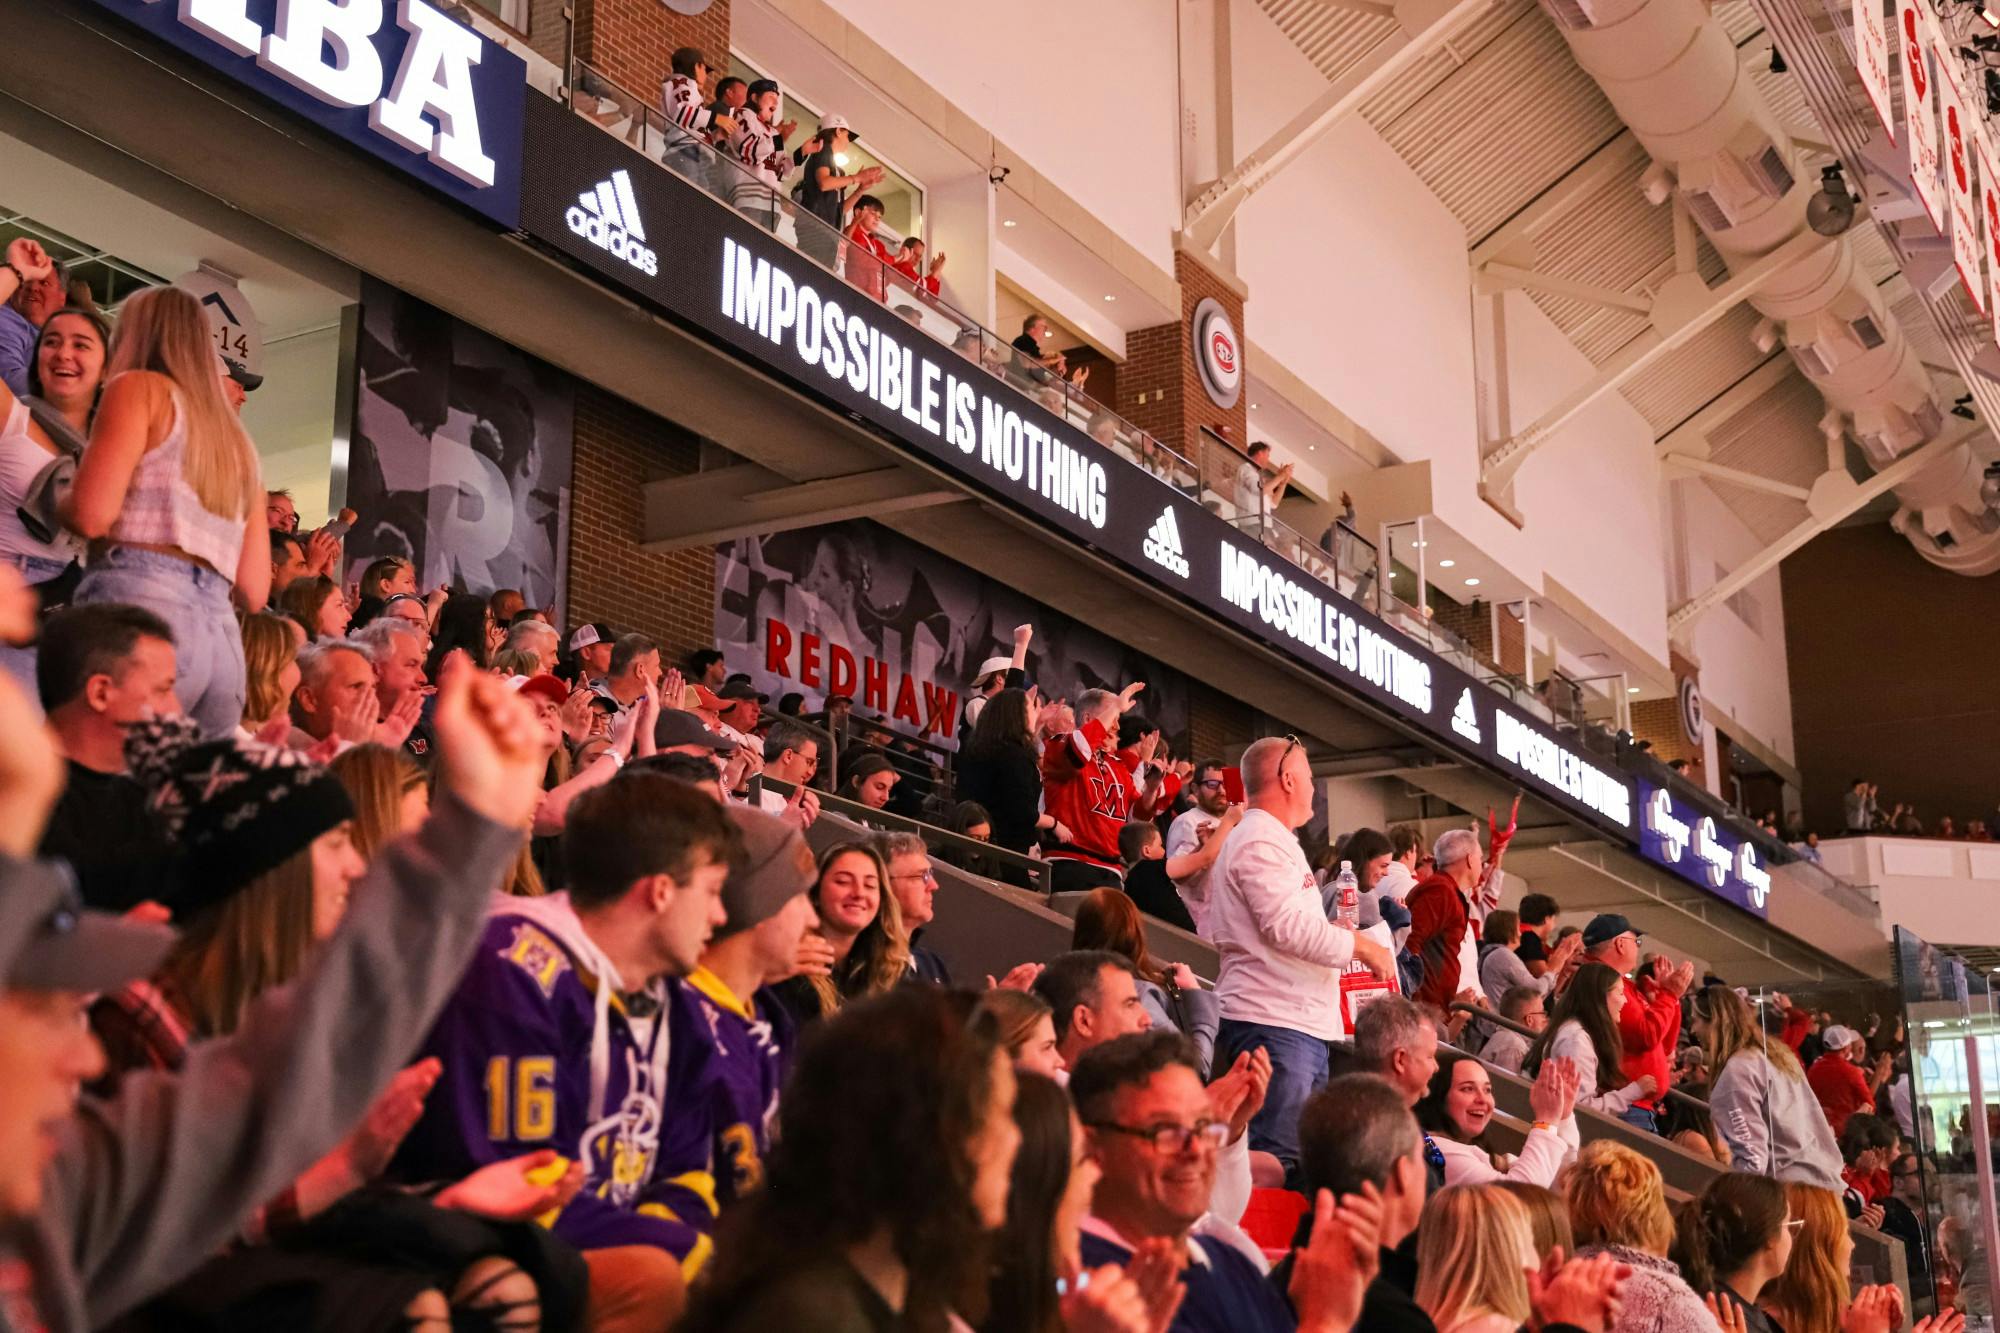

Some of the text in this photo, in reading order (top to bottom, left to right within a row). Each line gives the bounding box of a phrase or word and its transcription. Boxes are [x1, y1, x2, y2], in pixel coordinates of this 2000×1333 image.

[566, 206, 658, 277] adidas
[722, 237, 1107, 529] IMPOSSIBLE IS NOTHING
[1143, 538, 1190, 579] adidas
[1220, 540, 1432, 714] IMPOSSIBLE IS NOTHING
[485, 1054, 556, 1142] 16
